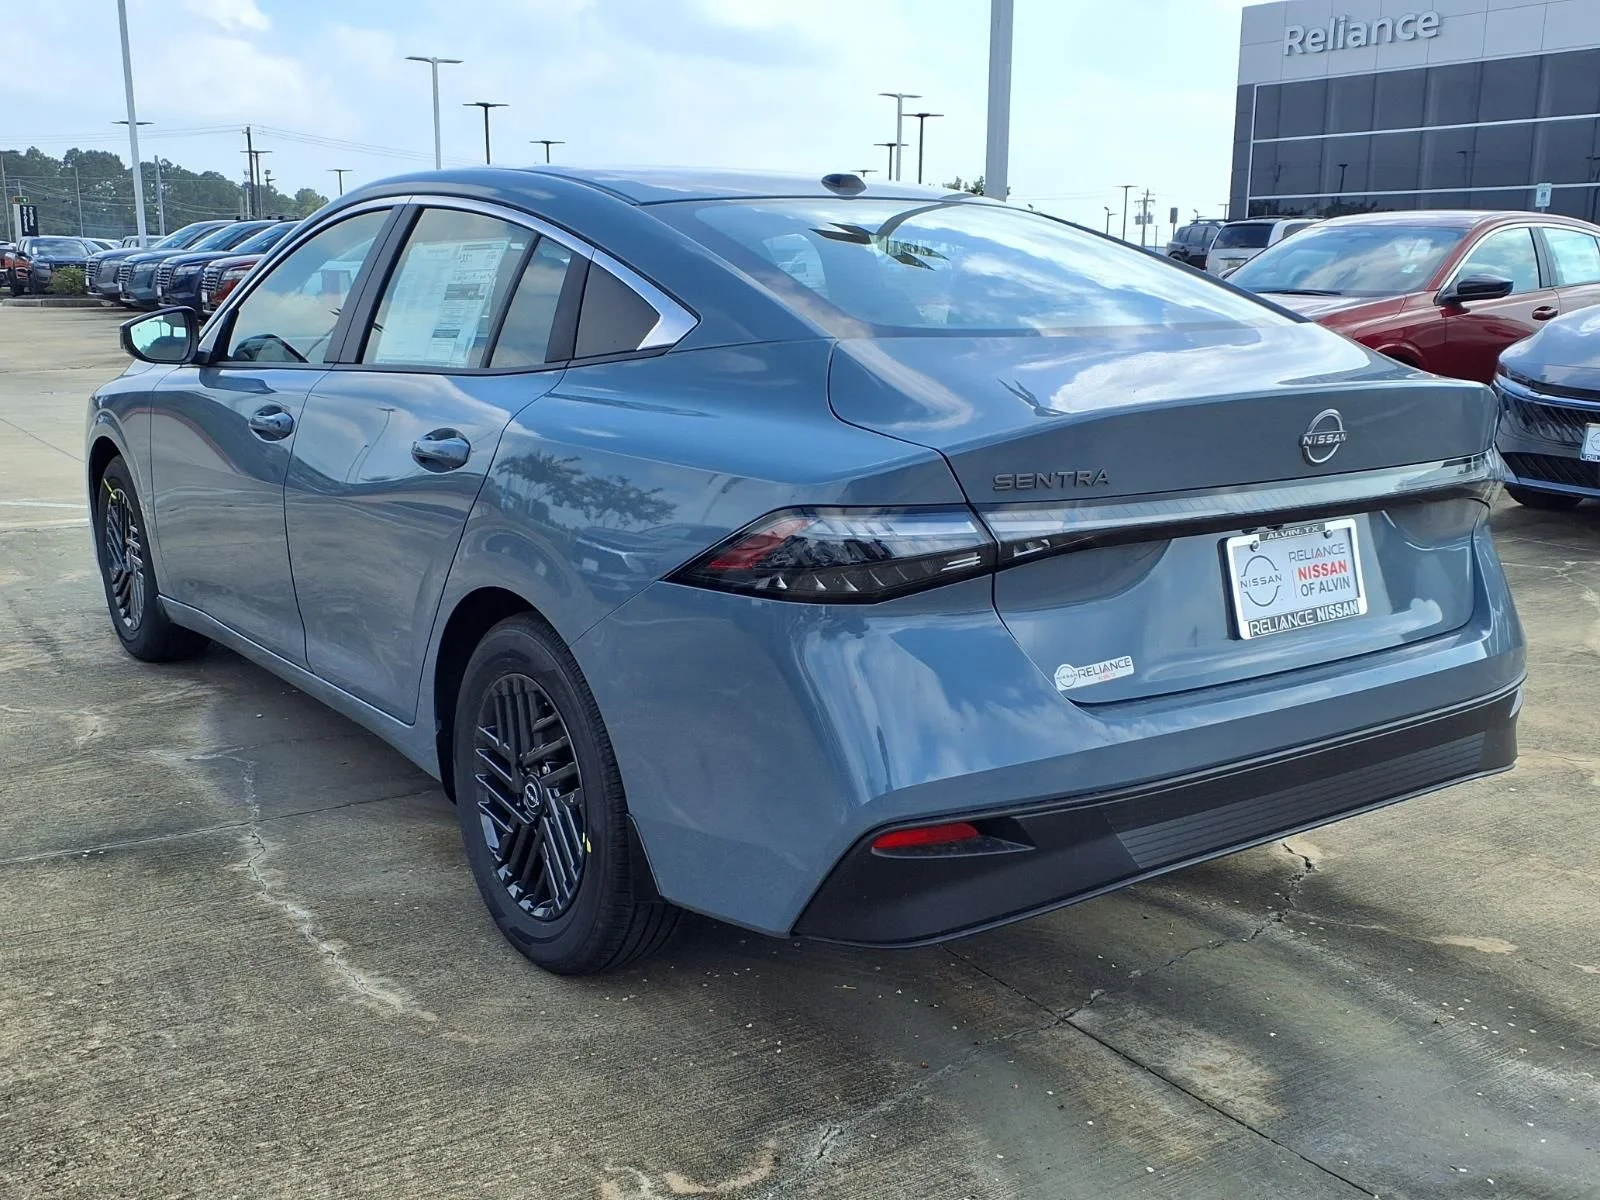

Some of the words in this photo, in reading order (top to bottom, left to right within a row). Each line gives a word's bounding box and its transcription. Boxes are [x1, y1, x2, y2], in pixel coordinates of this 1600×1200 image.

[1283, 10, 1440, 56] Reliance
[1303, 433, 1346, 445] NISSAN
[993, 469, 1109, 491] SENTRA
[1304, 525, 1319, 533] TX
[1288, 543, 1345, 563] RELIANCE
[1297, 559, 1347, 581] NISSAN
[1240, 574, 1282, 589] NISSAN
[1300, 582, 1315, 597] OF
[1319, 576, 1351, 594] ALVIN
[1250, 609, 1314, 637] RELIANCE
[1316, 599, 1359, 622] NISSAN
[1077, 657, 1132, 678] RELIANCE
